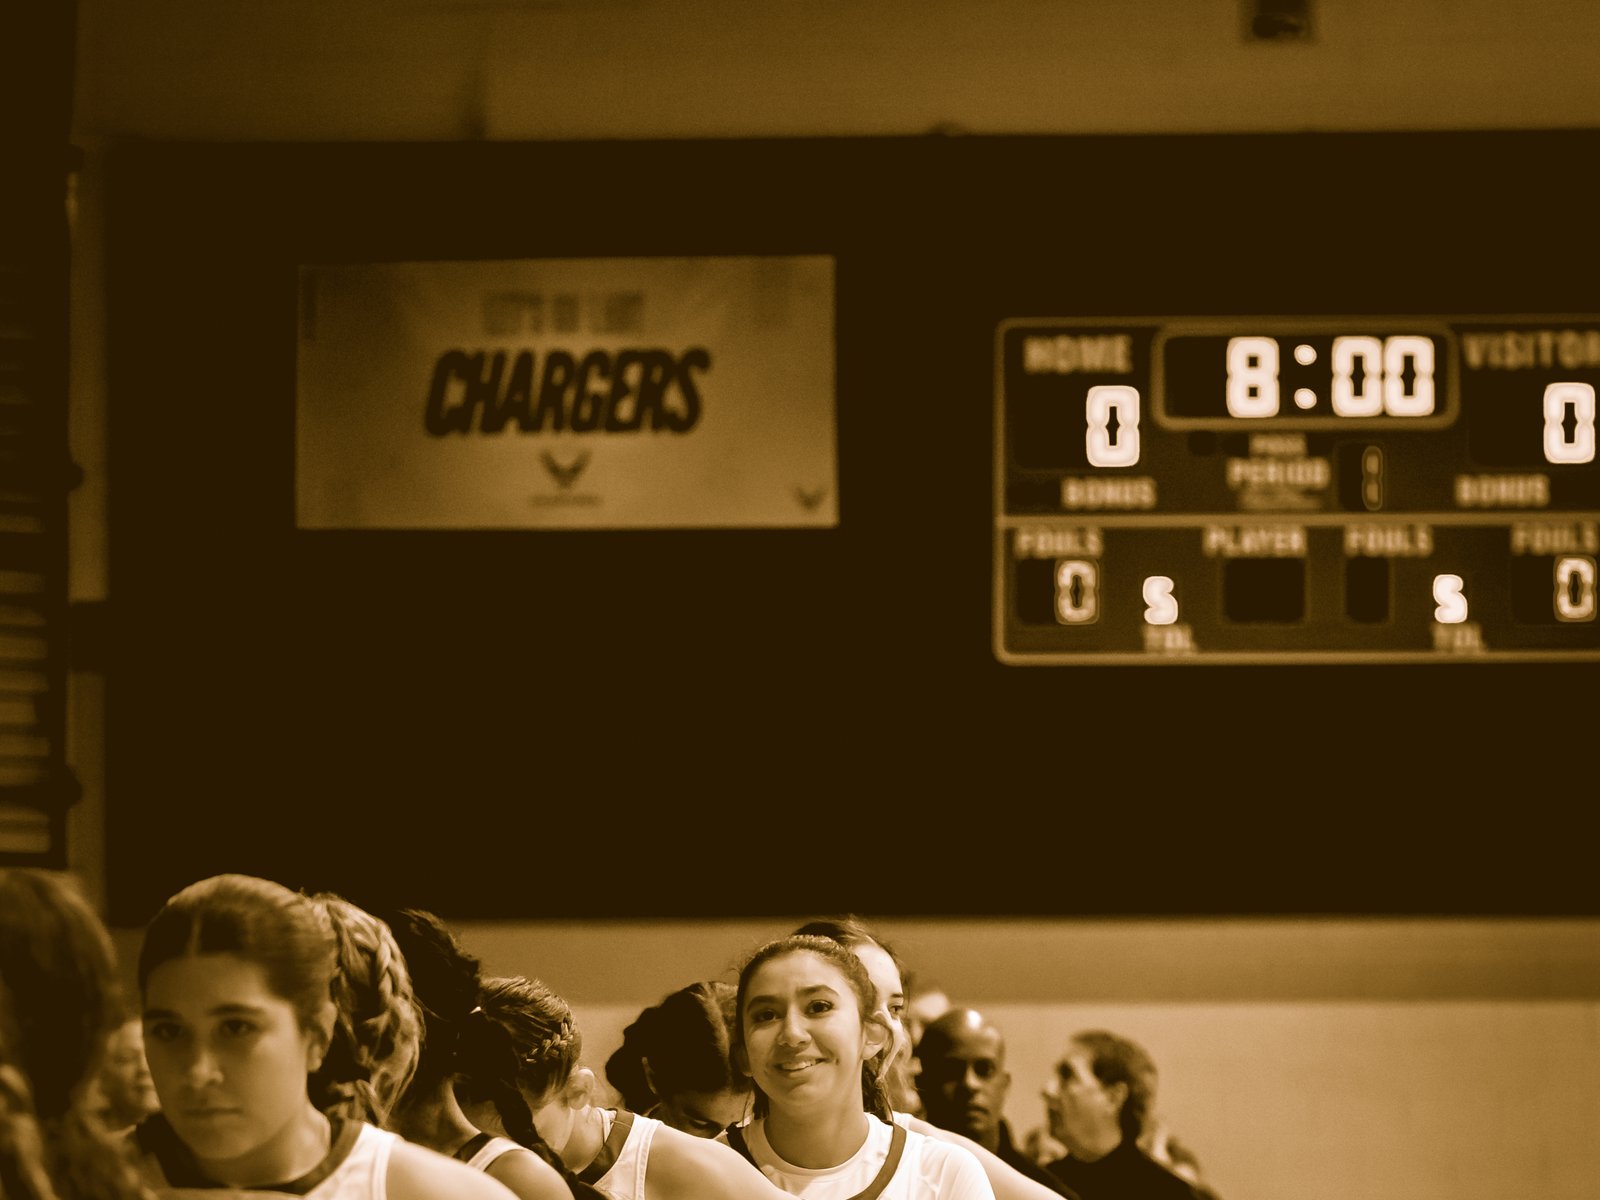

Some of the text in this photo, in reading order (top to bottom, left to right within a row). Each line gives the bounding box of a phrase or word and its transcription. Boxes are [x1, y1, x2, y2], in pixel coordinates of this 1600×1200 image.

[1024, 335, 1131, 374] HOME
[423, 346, 713, 438] CHARGERS
[1225, 336, 1435, 419] 8:00
[1086, 385, 1140, 468] 0
[1543, 382, 1596, 464] 0
[1227, 458, 1332, 490] PERIOD
[1455, 474, 1549, 507] BONUS
[1062, 477, 1156, 510] BONUS
[1014, 526, 1103, 556] FOULS
[1204, 526, 1307, 557] PLAYER
[1345, 525, 1433, 556] FOULS
[1511, 523, 1599, 554] FOULS
[1056, 558, 1099, 625] 0
[1554, 555, 1597, 622] 0
